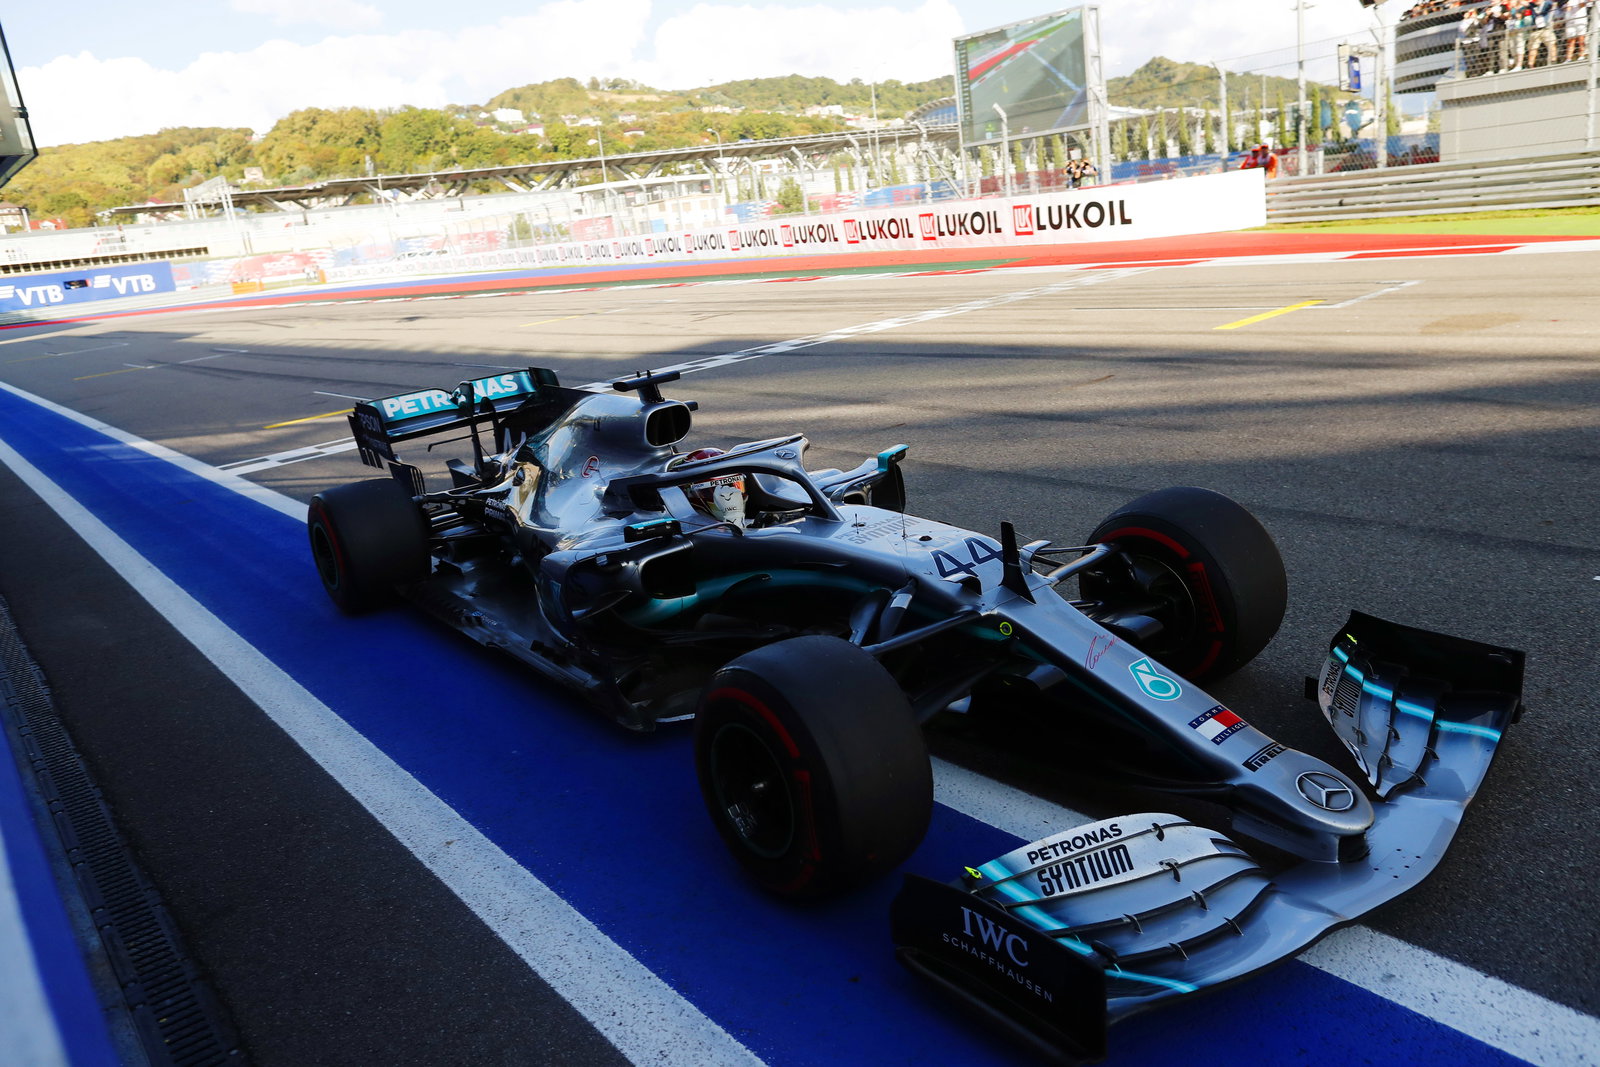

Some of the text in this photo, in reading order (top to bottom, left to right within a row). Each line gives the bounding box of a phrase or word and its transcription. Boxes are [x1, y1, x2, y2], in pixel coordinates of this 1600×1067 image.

[653, 237, 682, 254] LUKOIL
[692, 233, 726, 251] LUKOIL
[739, 228, 778, 248] LUKOIL
[792, 223, 839, 244] LUKOIL
[858, 218, 914, 241] LUKOIL
[937, 210, 1002, 237] LUKOIL
[1036, 200, 1133, 231] LUKOIL
[16, 274, 156, 306] VTB VTB
[847, 517, 921, 545] SYNTIUM
[929, 536, 1004, 579] 44
[1322, 661, 1341, 697] PETRONAS
[1192, 705, 1224, 727] TOMMY
[1214, 720, 1247, 744] HILFIGER
[1242, 741, 1289, 773] PIRELL
[1027, 823, 1123, 865] PETRONAS
[1037, 843, 1135, 897] SYNTIUM
[960, 906, 1029, 967] IWC
[942, 933, 1053, 1003] SCHAFFHAUSEN
